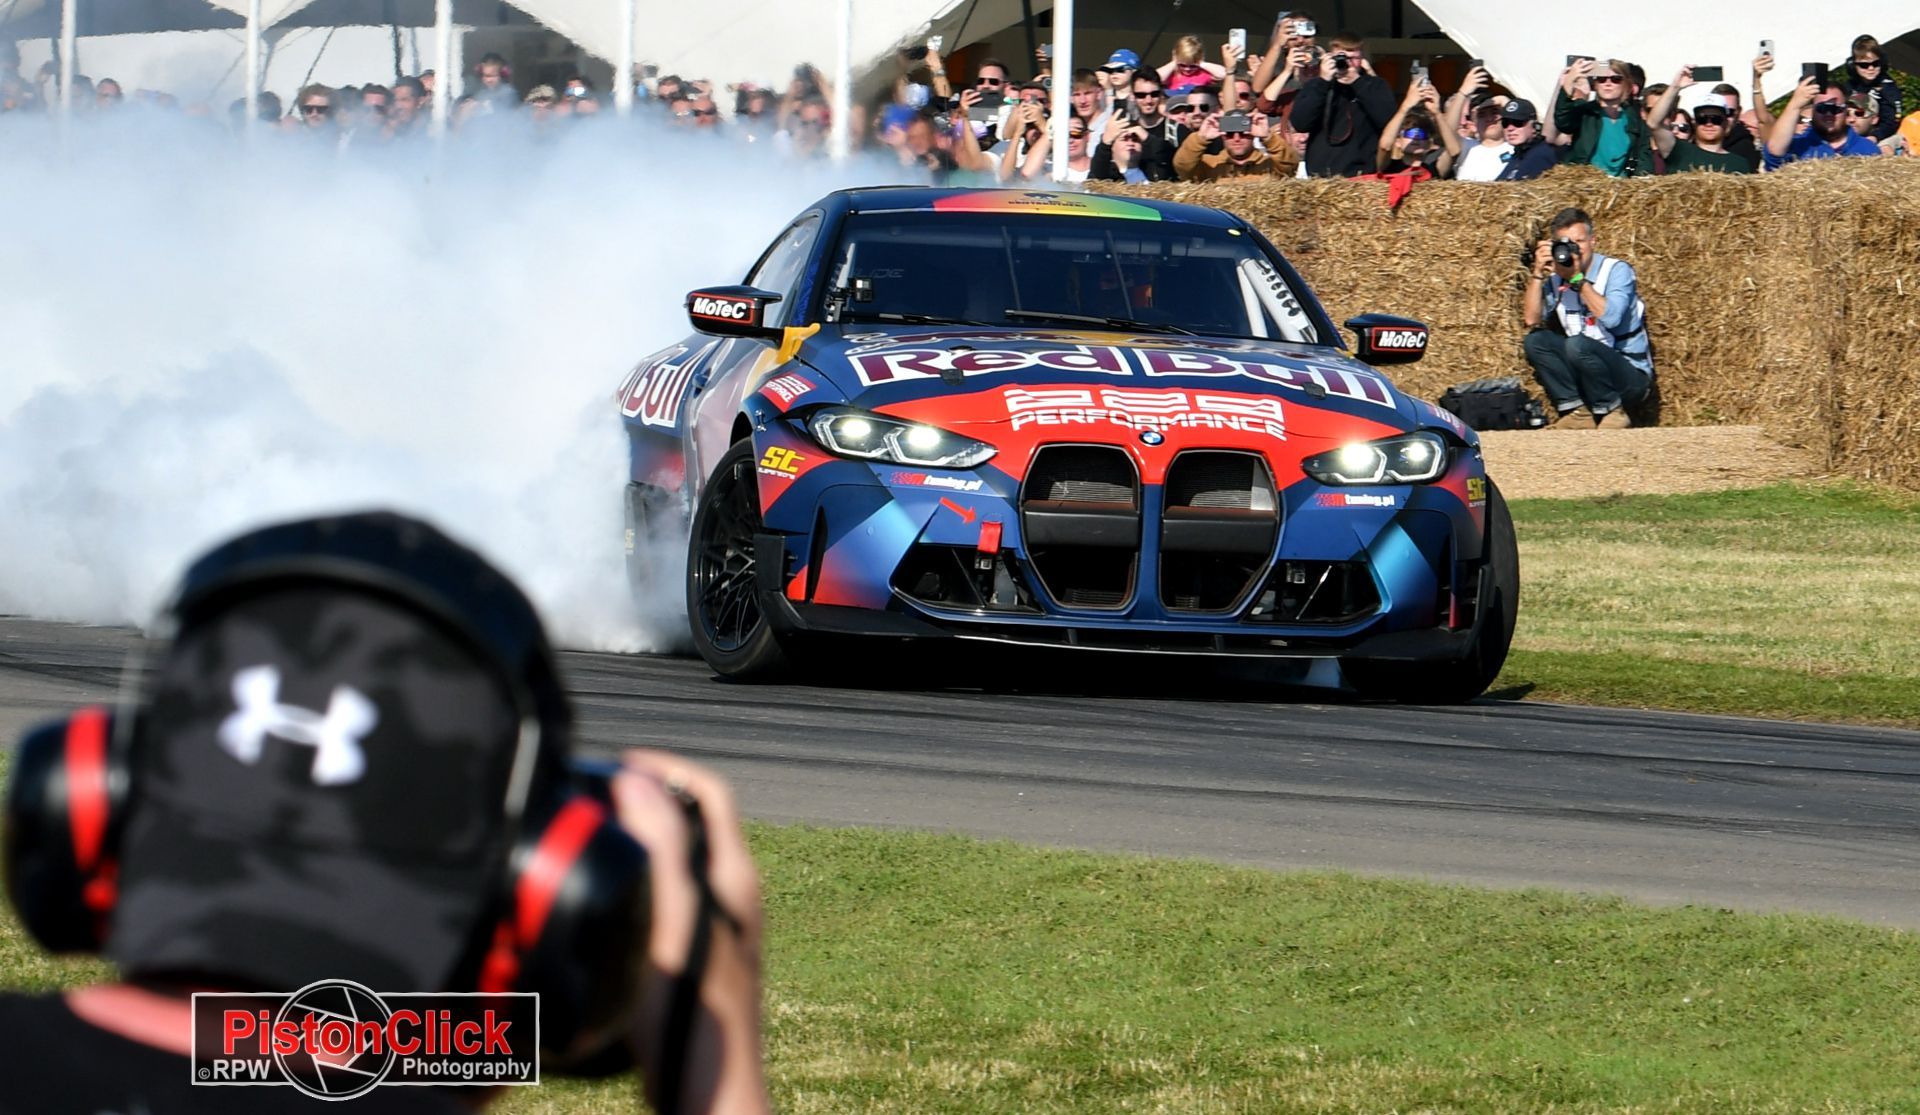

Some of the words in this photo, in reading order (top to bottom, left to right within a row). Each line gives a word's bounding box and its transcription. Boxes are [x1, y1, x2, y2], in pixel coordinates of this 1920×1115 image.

[692, 297, 747, 319] MoTeC
[1378, 330, 1427, 348] MoTeC
[839, 345, 1133, 386] Red
[1131, 348, 1396, 409] Bull
[1001, 408, 1288, 442] PERFORMANCE
